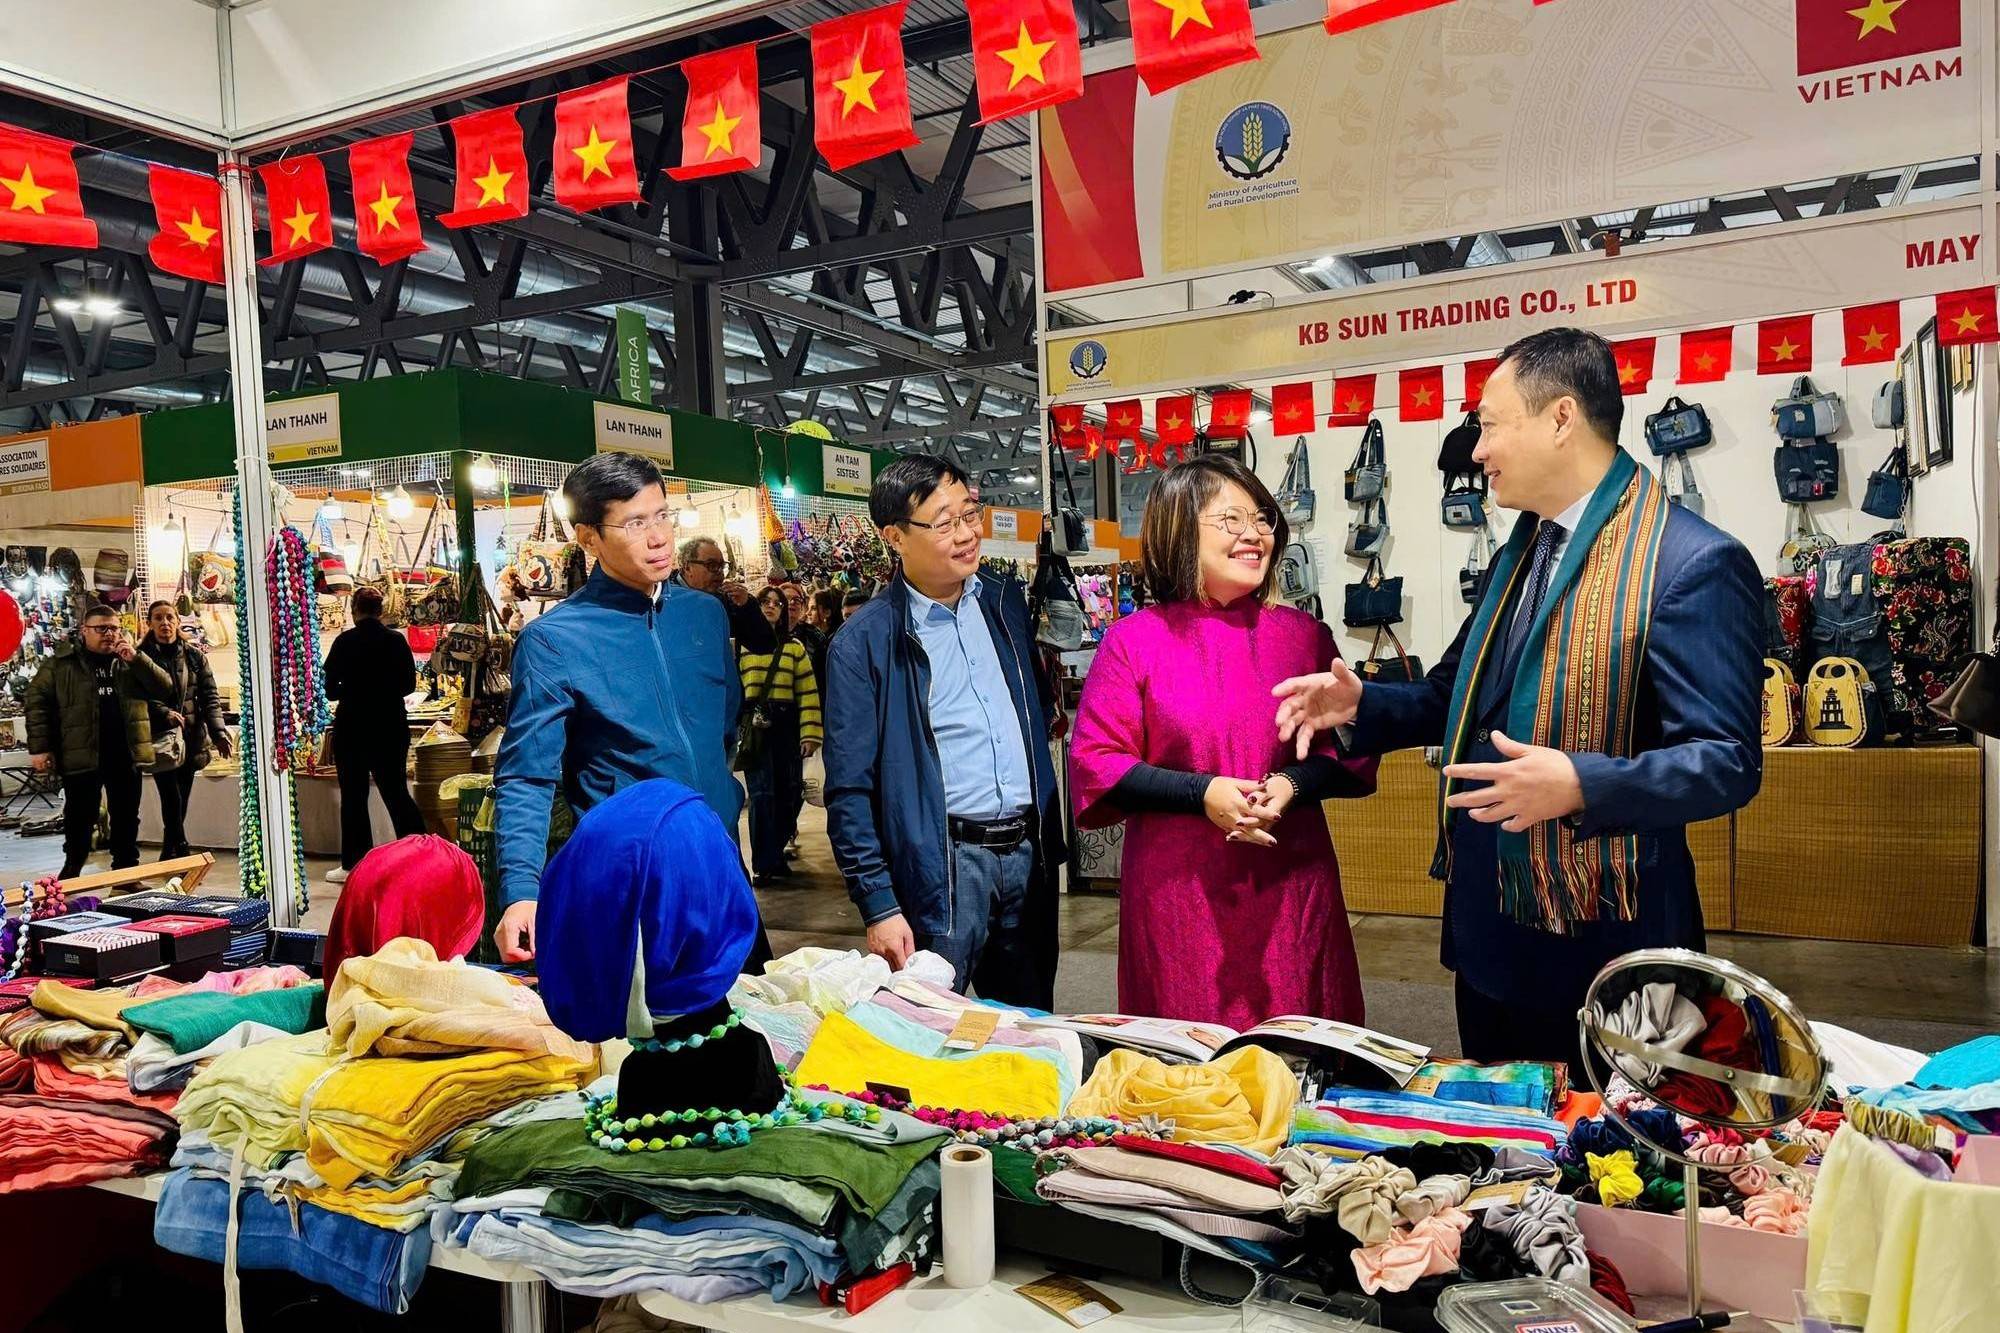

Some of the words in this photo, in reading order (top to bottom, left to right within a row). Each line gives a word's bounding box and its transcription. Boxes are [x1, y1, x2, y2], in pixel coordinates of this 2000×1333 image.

[1797, 56, 1962, 104] VIETNAM
[1207, 201, 1222, 210] and
[1223, 197, 1244, 207] Rural
[1246, 187, 1300, 203] Development
[1209, 188, 1241, 200] Ministry
[1242, 186, 1251, 194] of
[1252, 179, 1297, 192] Agriculture
[1906, 234, 1981, 269] MAY
[1298, 321, 1329, 346] KB
[1338, 313, 1387, 341] SUN
[1396, 296, 1510, 332] TRADING
[1520, 289, 1576, 316] CO.,
[1586, 279, 1637, 308] LTD
[628, 336, 641, 402] AFRICA
[266, 418, 287, 431] LAN
[289, 411, 327, 428] THANH
[606, 419, 626, 433] LAN
[628, 423, 662, 439] THANH
[307, 445, 339, 456] VIETNAM
[835, 454, 845, 463] AN
[846, 456, 860, 466] TAM
[11, 460, 46, 474] SOLIDAIRES
[836, 467, 860, 479] SISTERS
